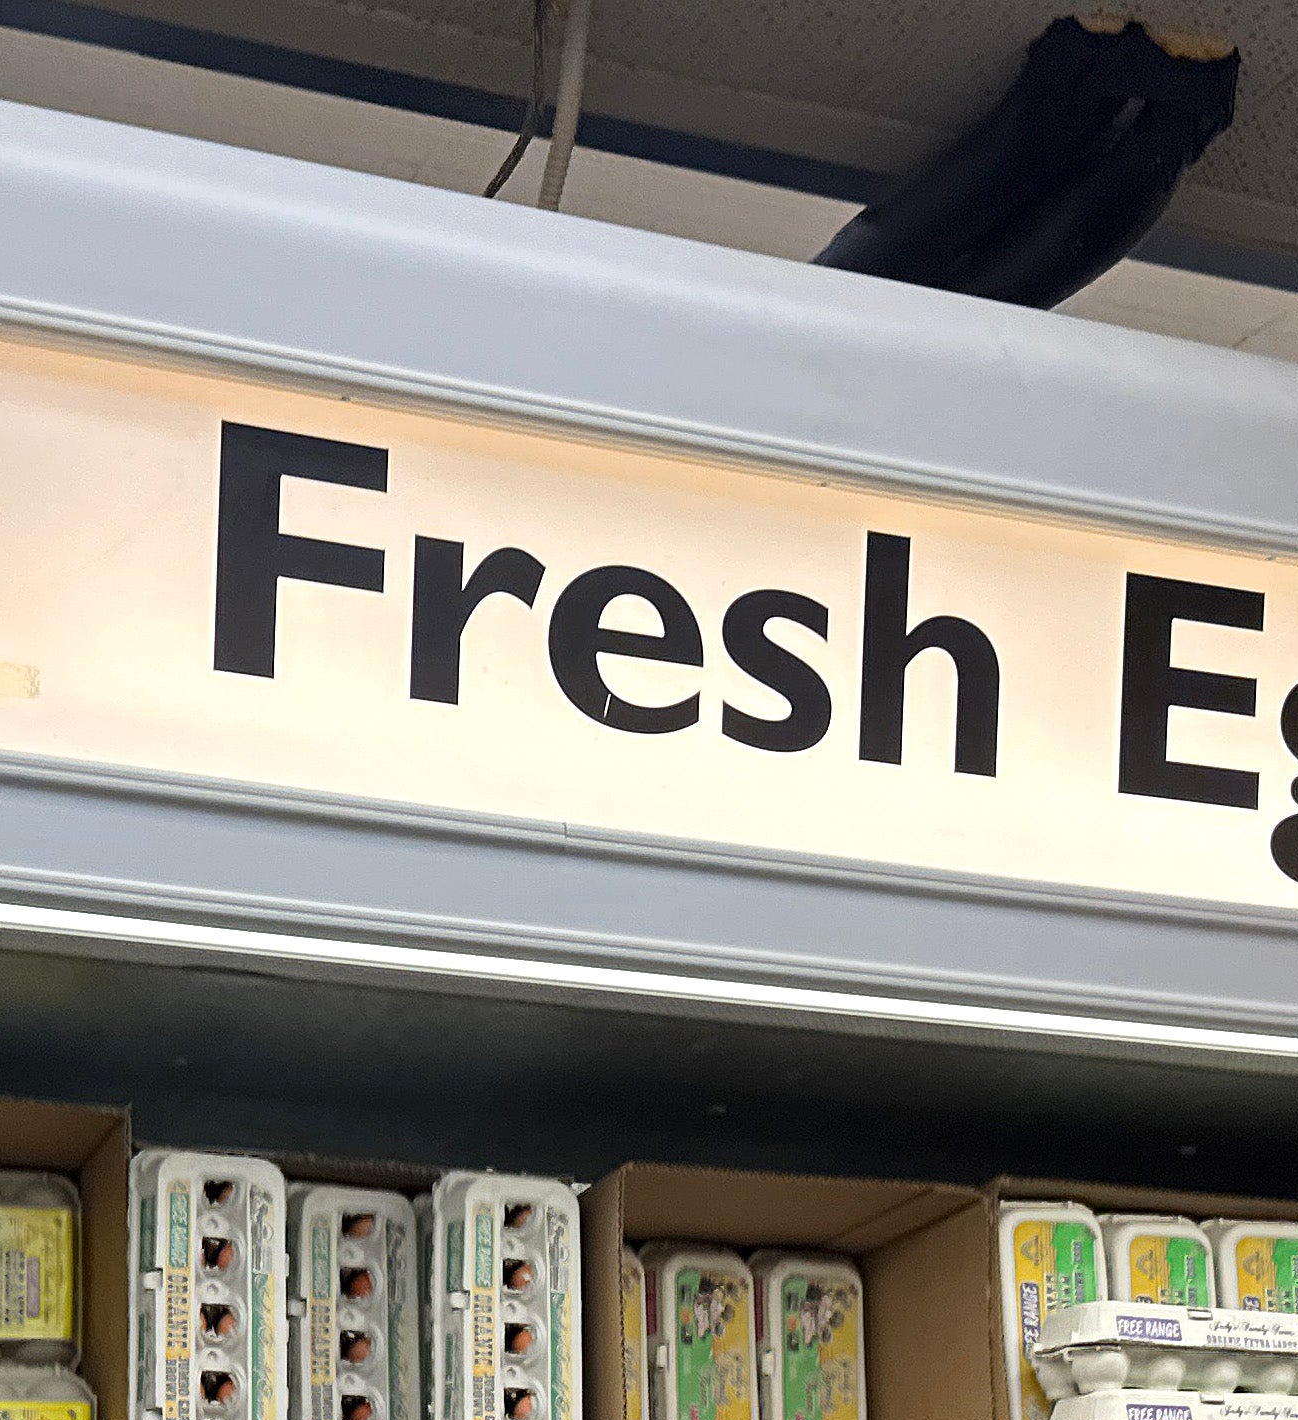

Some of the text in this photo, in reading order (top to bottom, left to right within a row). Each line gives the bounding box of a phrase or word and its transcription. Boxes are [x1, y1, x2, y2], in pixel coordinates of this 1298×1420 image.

[212, 420, 999, 778] Fresh
[1118, 1319, 1181, 1339] FREE RANGE
